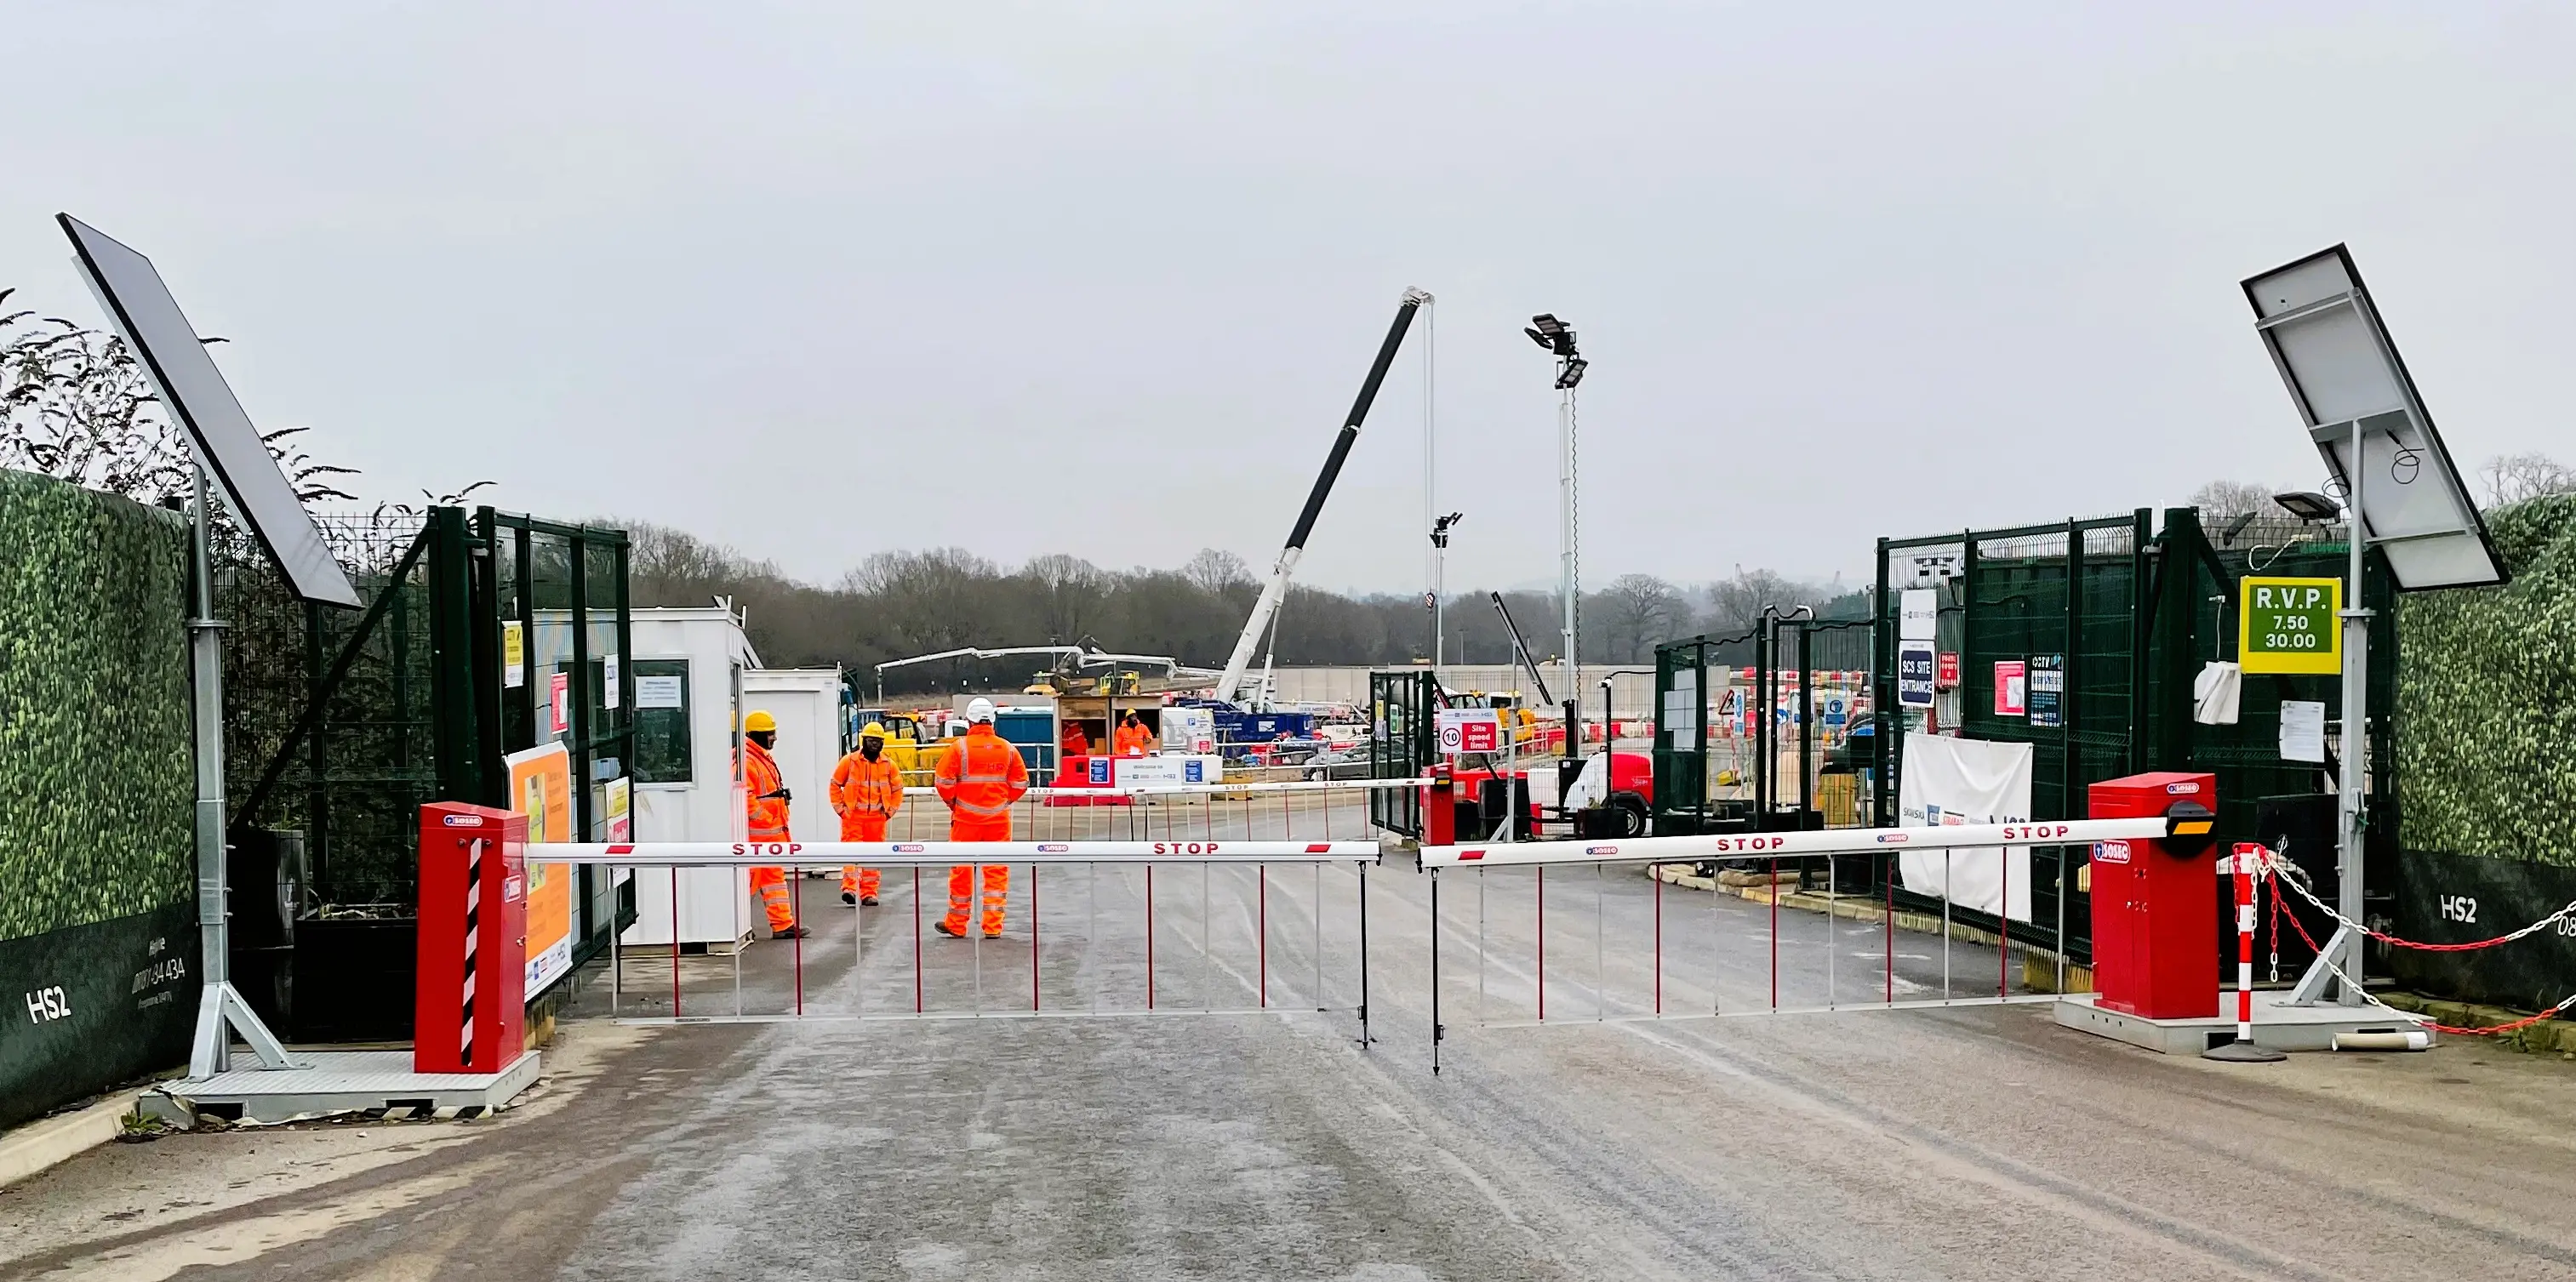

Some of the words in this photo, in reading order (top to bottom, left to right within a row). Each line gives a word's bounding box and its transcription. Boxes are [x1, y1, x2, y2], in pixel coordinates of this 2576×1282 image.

[2257, 587, 2327, 609] R.V.P.
[2273, 615, 2309, 630] 7.50
[2265, 633, 2316, 648] 30.00
[1902, 659, 1915, 673] SCS
[1916, 660, 1931, 675] SITE
[1900, 679, 1933, 694] ENTRANCE
[1445, 732, 1458, 742] 10
[1468, 733, 1491, 742] speed
[2003, 825, 2069, 840] STOP
[732, 843, 802, 855] STOP
[1154, 842, 1219, 854] STOP
[1717, 837, 1784, 851] STOP
[2103, 843, 2128, 860] SOSEC
[2440, 894, 2477, 924] HS2
[165, 957, 186, 980] 434
[26, 985, 71, 1024] HS2
